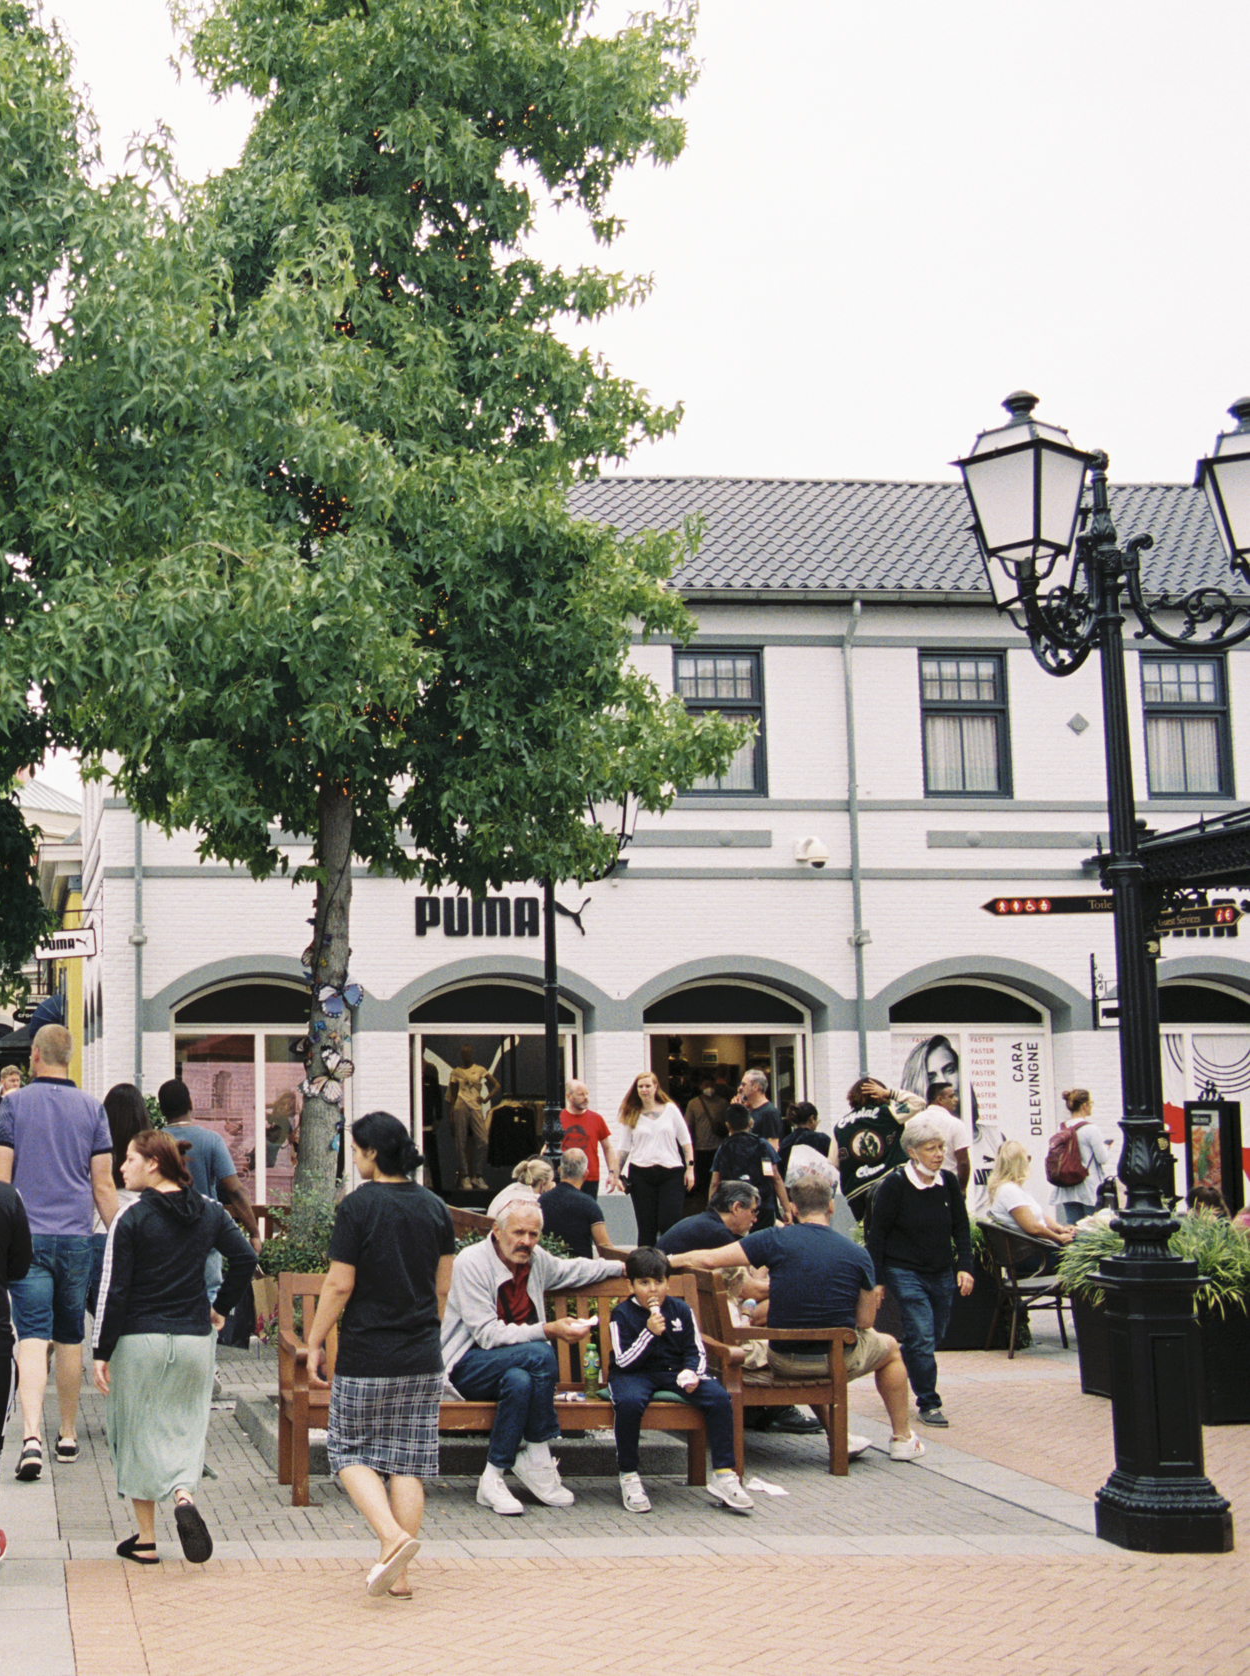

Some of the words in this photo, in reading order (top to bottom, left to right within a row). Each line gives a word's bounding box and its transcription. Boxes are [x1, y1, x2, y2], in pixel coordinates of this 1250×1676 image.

[415, 896, 539, 936] PUMA
[1088, 899, 1113, 910] Toile
[1011, 1042, 1024, 1082] CARA
[1027, 1042, 1042, 1136] DELEVINGNE
